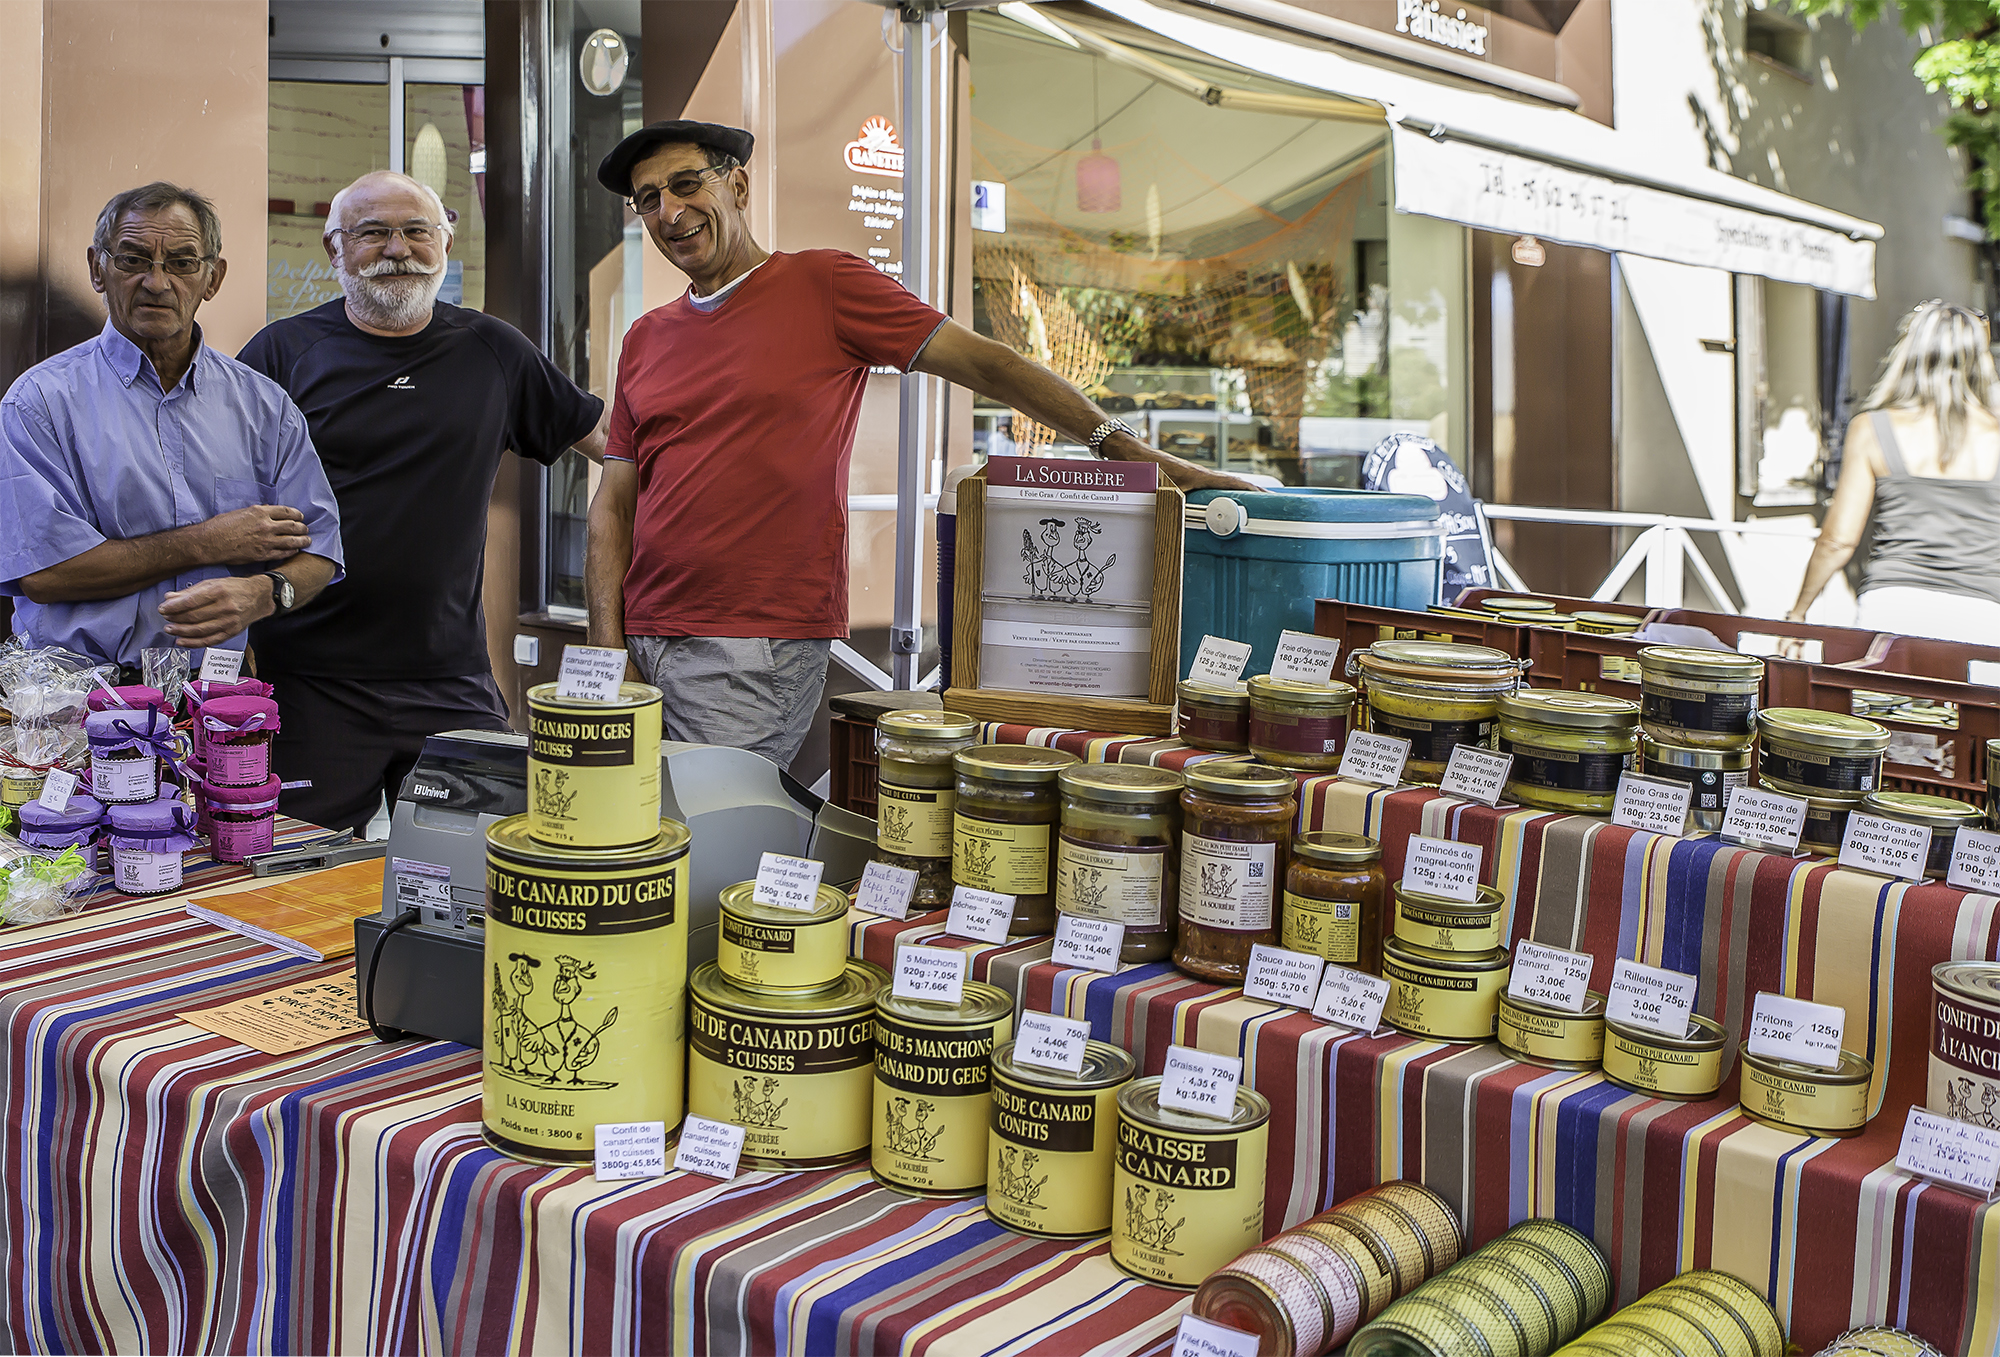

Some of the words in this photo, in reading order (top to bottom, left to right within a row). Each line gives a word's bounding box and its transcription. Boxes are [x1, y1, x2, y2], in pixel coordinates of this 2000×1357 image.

[1039, 465, 1125, 487] SOURBÈRE
[210, 654, 231, 662] Confiture
[537, 719, 580, 740] CANARD
[581, 723, 600, 740] DU
[601, 722, 632, 741] GERS
[538, 740, 573, 758] CUISSES
[1372, 740, 1391, 753] Gras
[1351, 747, 1376, 759] canard
[1378, 753, 1400, 764] entier
[1475, 754, 1493, 767] Gras
[1370, 761, 1397, 774] 51,50€
[1454, 760, 1478, 772] canard
[1479, 767, 1501, 778] entier
[1471, 776, 1498, 789] 41,10€
[421, 787, 450, 799] Uniwell
[1626, 784, 1645, 796] Foie
[1648, 788, 1669, 800] Gras
[1672, 792, 1684, 801] de
[1624, 796, 1654, 809] canard
[1656, 802, 1682, 813] entier
[1738, 795, 1758, 807] Foie
[1760, 799, 1784, 812] Gras
[1786, 805, 1798, 815] de
[1622, 807, 1647, 821] 180g:
[1649, 812, 1682, 824] 23,50€
[1734, 806, 1767, 820] canard
[1769, 813, 1796, 825] entier
[1857, 817, 1879, 828] Foie
[1882, 822, 1907, 835] Gras
[1910, 828, 1923, 838] de
[1853, 829, 1889, 843] canard
[1891, 836, 1922, 849] entier
[1968, 839, 1991, 851] Bloc
[1849, 840, 1870, 854] 80g
[1880, 847, 1908, 860] 15,05
[1955, 850, 1979, 862] gras
[761, 865, 787, 876] canard
[774, 856, 798, 869] Confit
[1415, 854, 1446, 868] magret
[1449, 860, 1475, 872] confit
[1958, 862, 1985, 877] 190g
[1412, 866, 1436, 879] 125g
[1444, 872, 1464, 883] 4,40
[498, 874, 516, 897] DE
[517, 879, 599, 907] CANARD
[602, 884, 632, 907] DU
[634, 875, 674, 903] GERS
[759, 885, 778, 897] 350g
[774, 878, 799, 889] cuisse
[964, 891, 990, 903] Canard
[511, 905, 524, 924] 10
[525, 907, 587, 931] CUISSES
[1070, 918, 1101, 930] Canard
[755, 927, 792, 942] CANARD
[1071, 929, 1104, 943] l'orange
[1058, 938, 1082, 951] 750g:
[1084, 944, 1112, 956] 14,40€
[914, 955, 958, 969] Manchons
[1256, 953, 1283, 965] Sauce
[1299, 961, 1315, 971] bon
[1522, 945, 1570, 964] Migrelines
[1571, 955, 1588, 967] pur
[903, 966, 925, 979] 920g
[1259, 966, 1278, 977] petit
[1280, 967, 1306, 981] diable
[1518, 958, 1550, 971] canard
[1563, 967, 1588, 981] 125g
[1253, 977, 1278, 990] 350g:
[1281, 982, 1300, 993] 5,70
[1419, 975, 1447, 989] CANARD
[1624, 970, 1663, 989] Rillettes
[1666, 981, 1684, 993] pur
[1325, 978, 1350, 992] confits
[1362, 990, 1383, 1004] 240g
[1524, 985, 1572, 1004] kg:24,00€
[1613, 981, 1648, 996] canard
[1659, 992, 1688, 1008] 125g:
[1326, 1005, 1367, 1024] kg:21,67€
[1633, 999, 1662, 1014] 3,00€
[1023, 1019, 1051, 1032] Abattis
[1531, 1016, 1560, 1029] CANARD
[1755, 1012, 1794, 1028] Fritons
[1811, 1022, 1840, 1039] 125g
[1937, 1001, 1981, 1034] CONFIT
[708, 1015, 727, 1041] DE
[730, 1023, 813, 1051] CANARD
[818, 1027, 846, 1050] DU
[1761, 1027, 1792, 1042] 2,20€
[890, 1034, 904, 1054] DE
[915, 1037, 993, 1060] MANCHONS
[1619, 1039, 1649, 1057] RILLETTES
[1649, 1048, 1663, 1060] PUR
[1663, 1051, 1694, 1063] CANARD
[736, 1050, 795, 1072] CUISSES
[879, 1056, 924, 1083] CANARD
[927, 1066, 949, 1085] DU
[952, 1065, 987, 1086] GERS
[1169, 1058, 1203, 1074] Graisse
[1211, 1067, 1235, 1082] 720g
[1783, 1080, 1817, 1095] CANARD
[506, 1094, 519, 1108] LA
[520, 1097, 575, 1117] SOURBÈRE
[1011, 1094, 1027, 1116] DE
[1029, 1100, 1093, 1122] CANARD
[547, 1128, 573, 1140] 3800
[611, 1125, 638, 1136] Confit
[697, 1122, 718, 1134] Confit
[999, 1112, 1049, 1142] CONFITS
[603, 1136, 633, 1147] canard
[683, 1131, 708, 1144] canard
[1120, 1122, 1206, 1163] GRAISSE
[622, 1147, 655, 1157] cuisses
[694, 1144, 721, 1158] cuisses
[1126, 1152, 1231, 1187] CANARD
